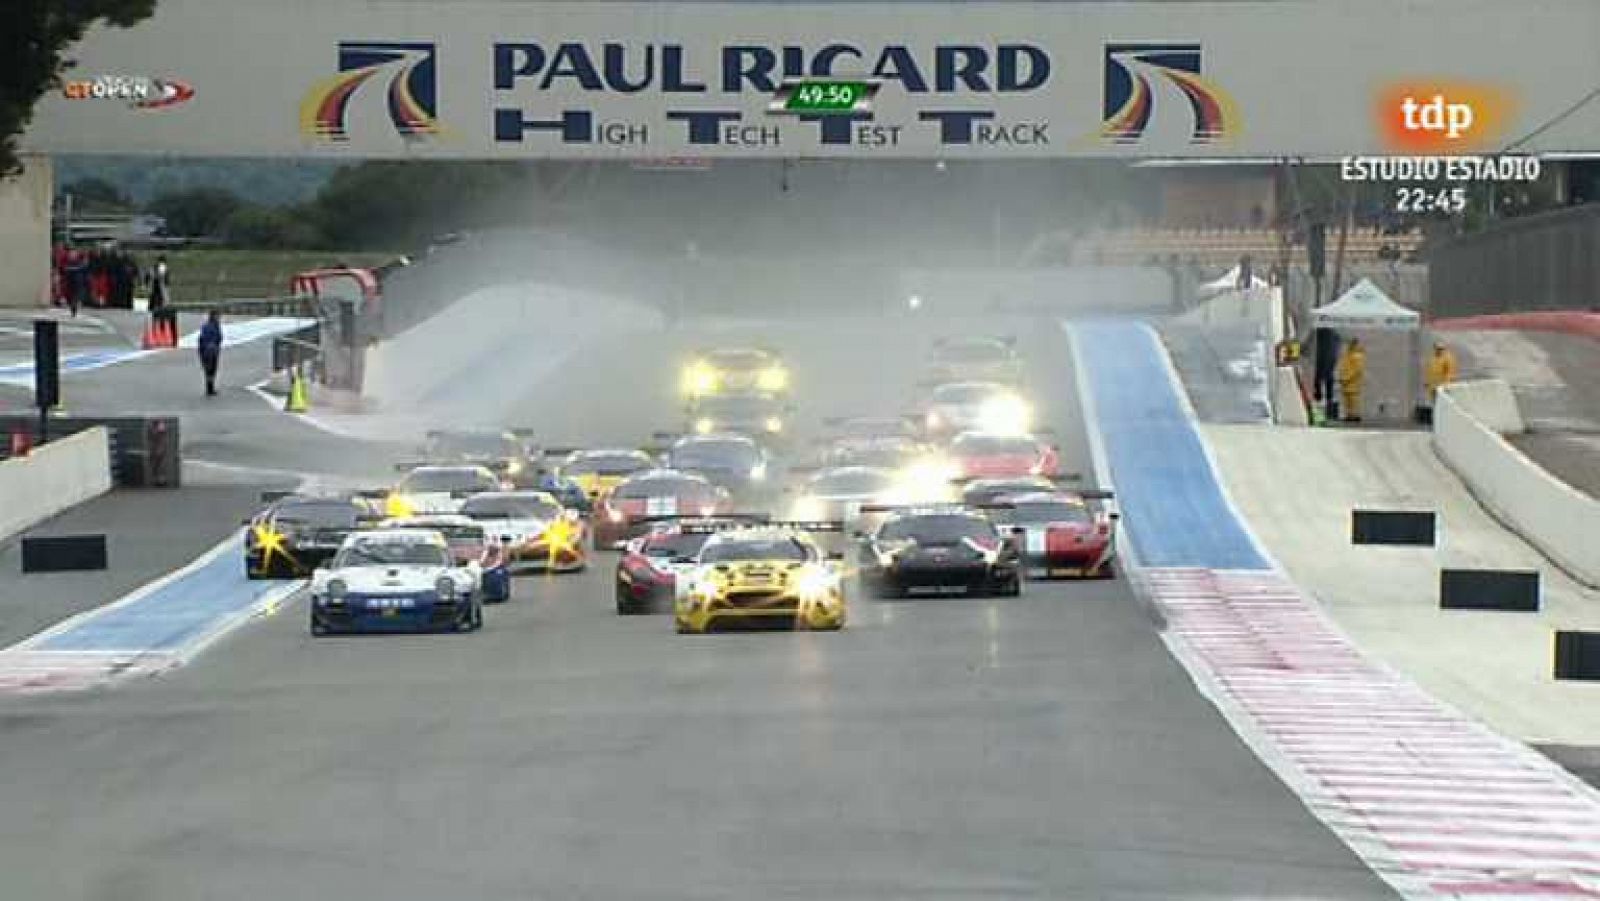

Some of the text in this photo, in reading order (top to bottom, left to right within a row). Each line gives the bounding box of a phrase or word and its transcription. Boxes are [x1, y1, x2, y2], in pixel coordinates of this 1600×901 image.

[493, 43, 1051, 93] PAUL RICARD
[494, 110, 1050, 145] HIGH TECH TEST TRACK
